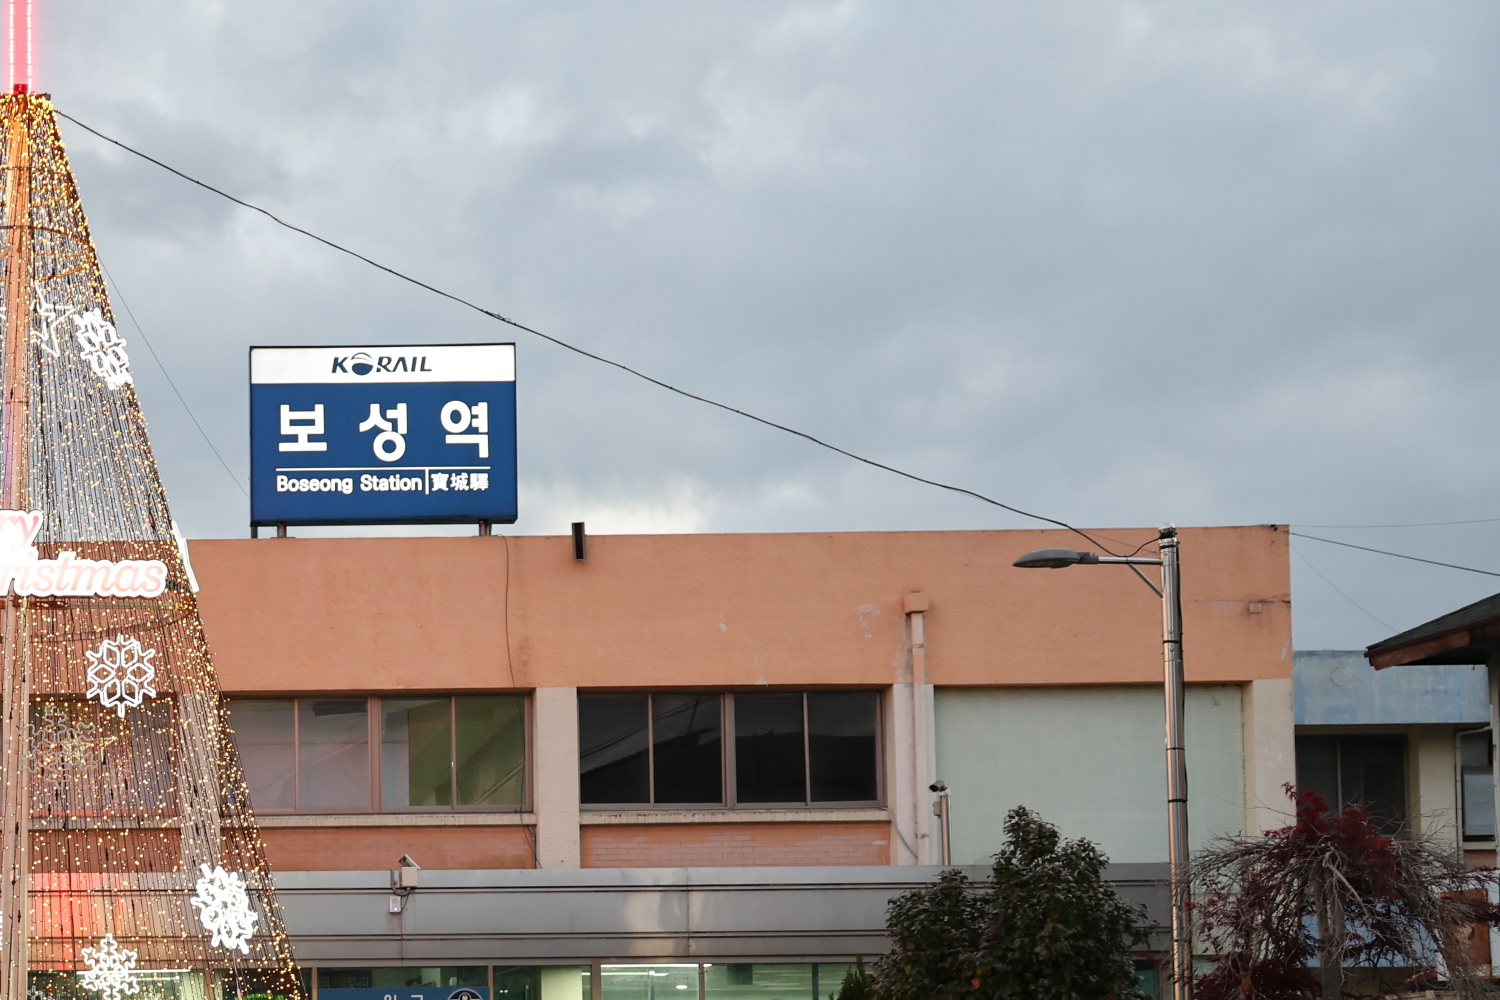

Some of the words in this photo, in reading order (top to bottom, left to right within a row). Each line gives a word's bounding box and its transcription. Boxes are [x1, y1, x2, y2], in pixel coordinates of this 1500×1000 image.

[331, 352, 432, 376] KORAIL
[276, 474, 353, 494] Boseong
[360, 473, 422, 492] Station
